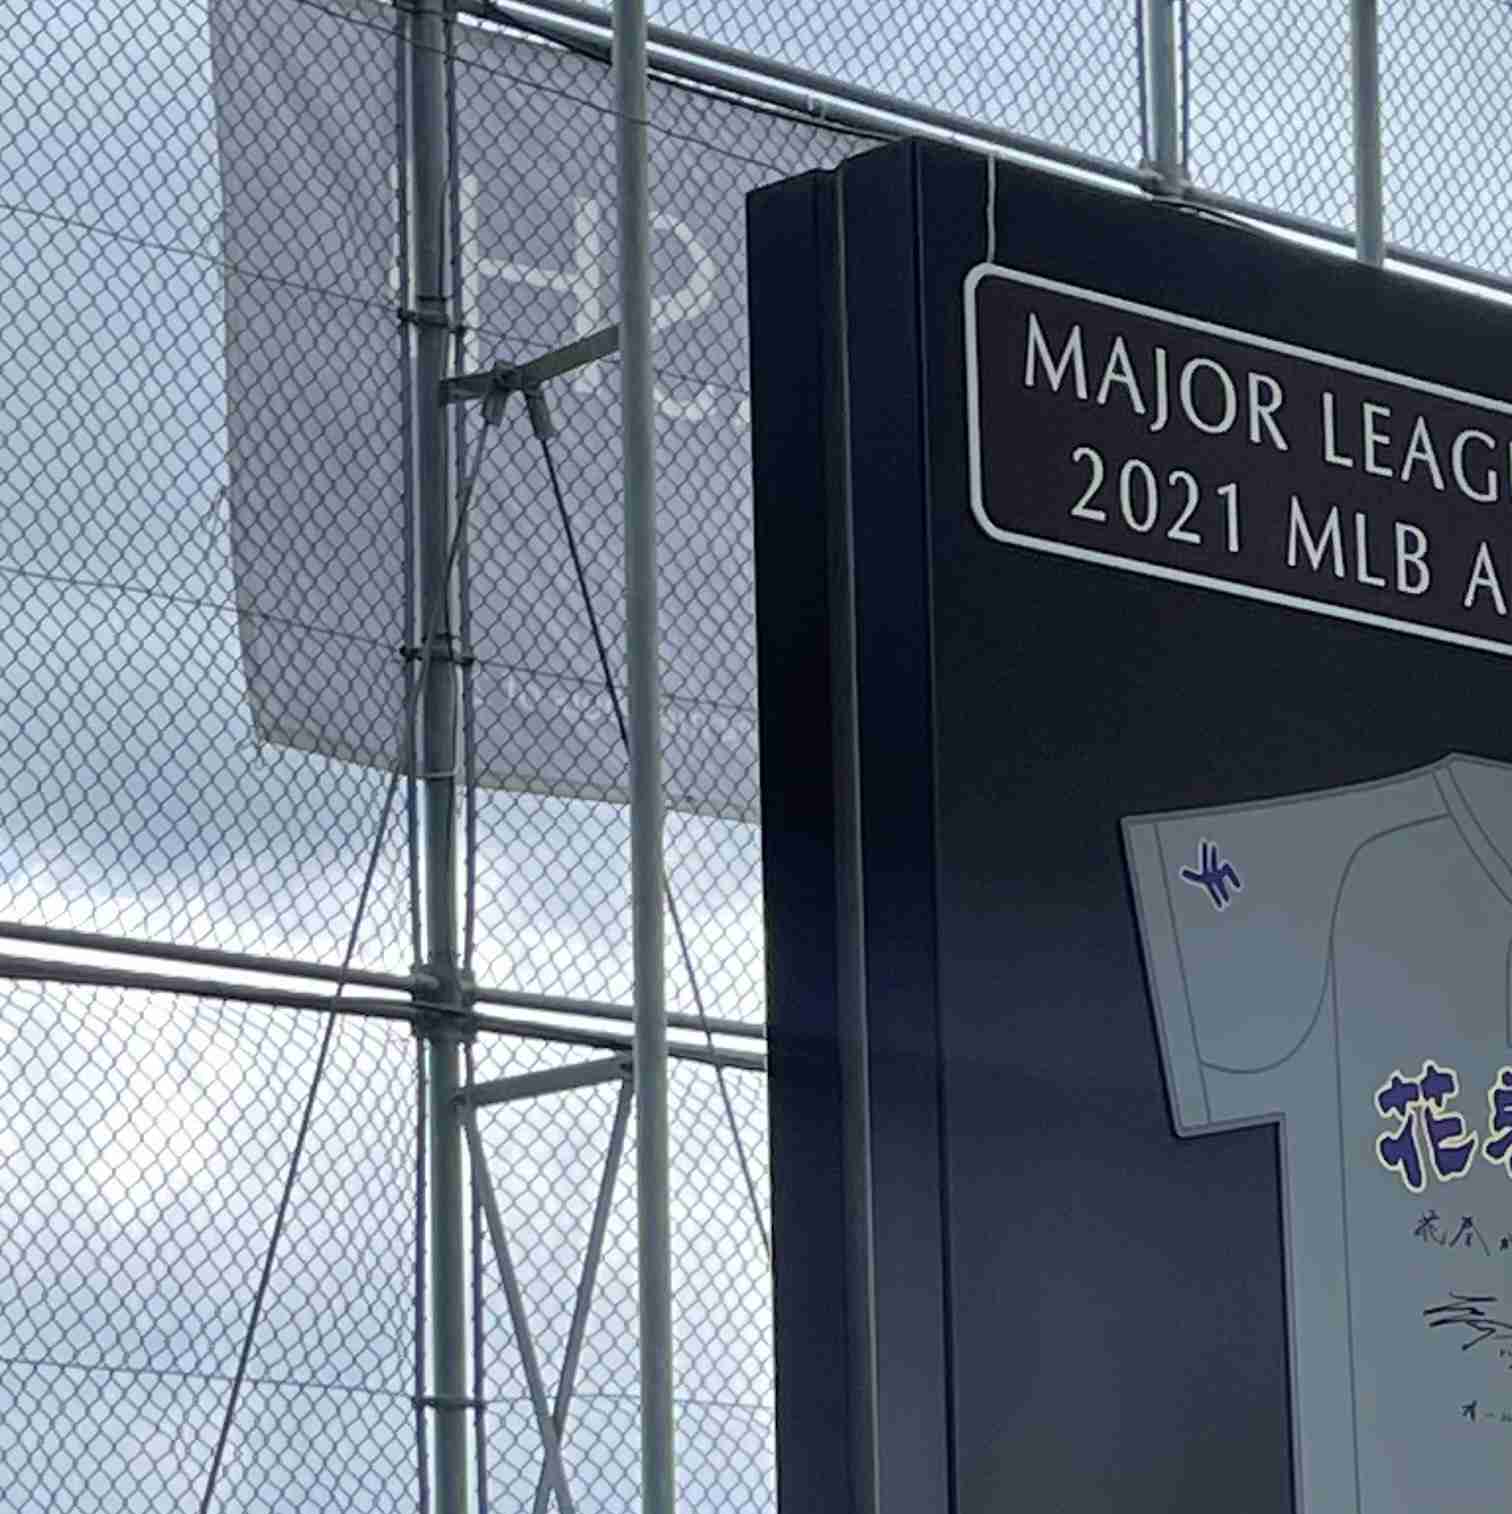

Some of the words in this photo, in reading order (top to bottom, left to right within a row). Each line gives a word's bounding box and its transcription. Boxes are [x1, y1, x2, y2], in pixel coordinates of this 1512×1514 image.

[1024, 311, 1288, 450] MAJOR
[1070, 446, 1240, 553] 2021
[1287, 496, 1432, 595] MLB
